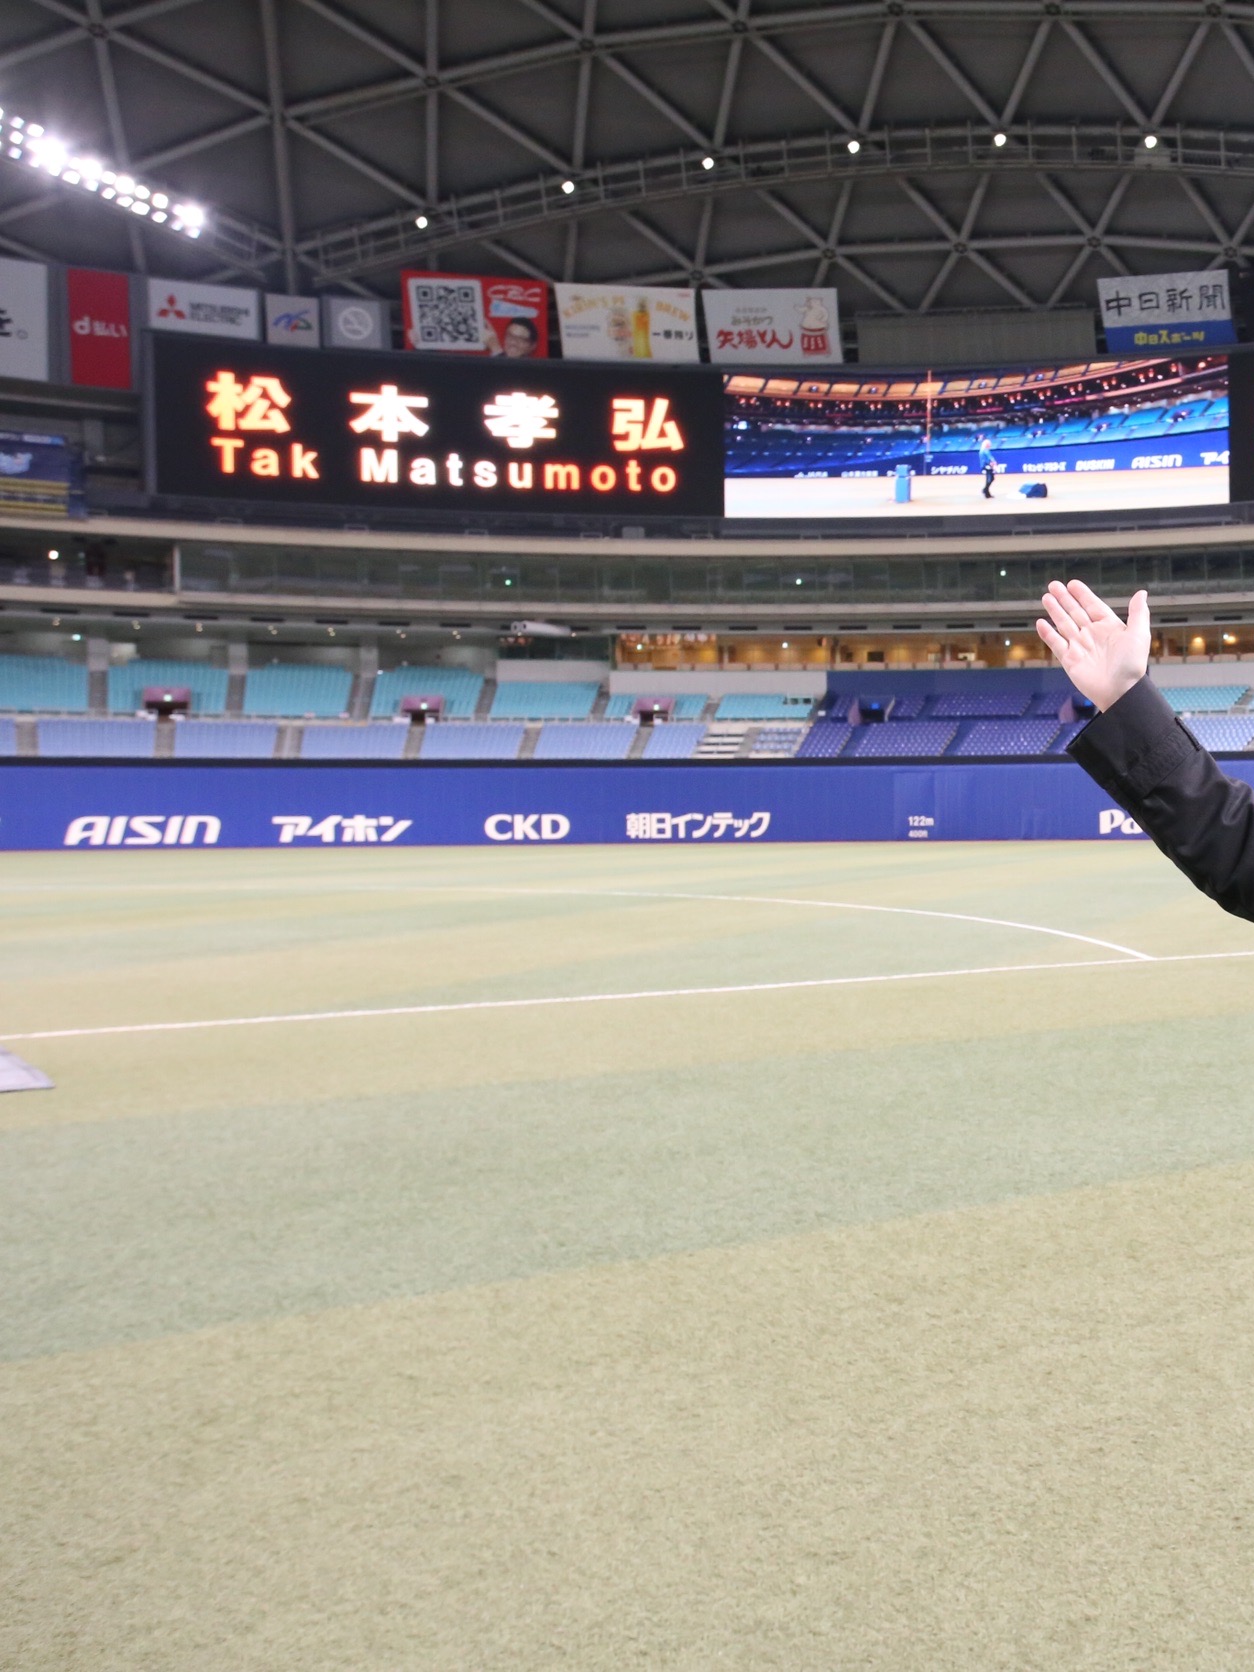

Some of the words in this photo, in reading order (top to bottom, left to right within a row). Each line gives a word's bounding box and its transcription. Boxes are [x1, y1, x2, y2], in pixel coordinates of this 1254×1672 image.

[1104, 284, 1226, 317] 中日新聞
[716, 328, 794, 350] 矢場とん
[205, 370, 685, 452] 松本孝弘
[210, 437, 320, 479] Tak
[360, 447, 678, 492] Matsumoto
[1131, 453, 1182, 469] AISIN
[64, 815, 221, 846] AISIN
[271, 814, 413, 843] アイホン
[484, 813, 570, 840] CKD
[626, 811, 771, 839] 朝日インテック
[908, 815, 934, 826] 122m
